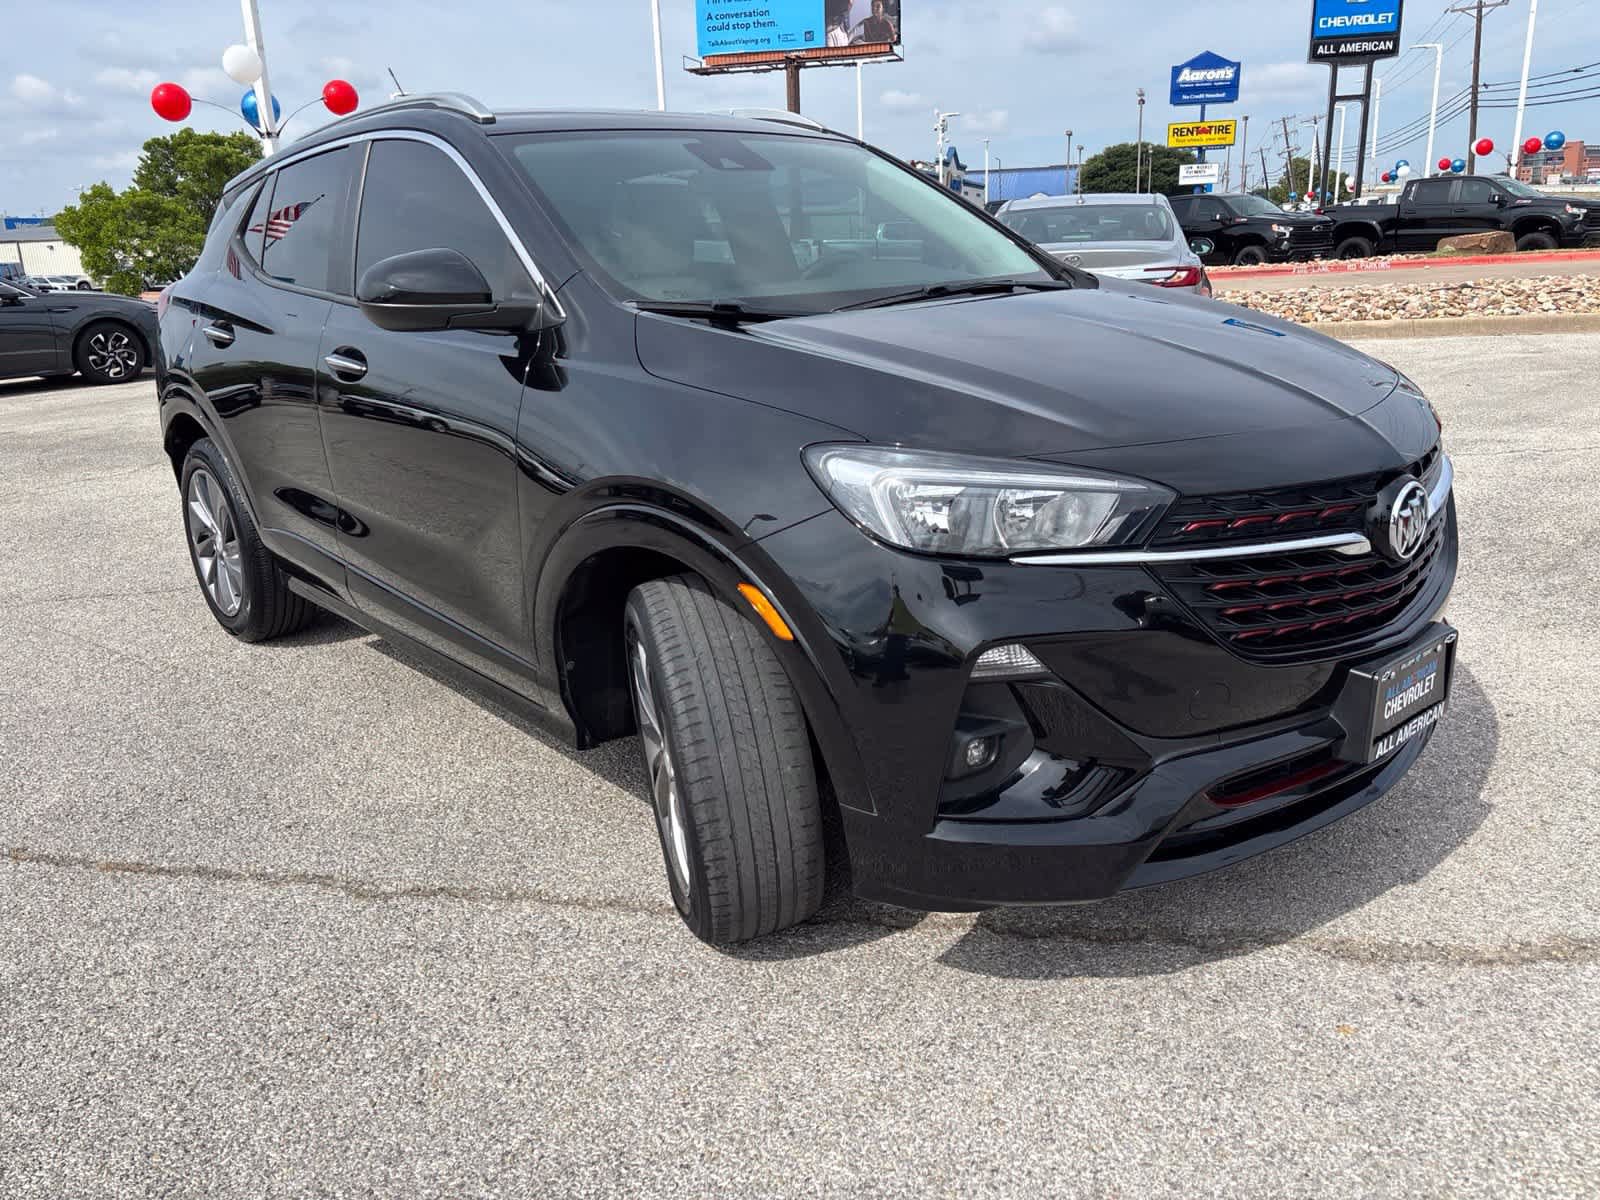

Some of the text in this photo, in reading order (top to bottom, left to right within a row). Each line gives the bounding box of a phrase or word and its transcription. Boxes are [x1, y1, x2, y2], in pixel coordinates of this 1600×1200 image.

[706, 8, 770, 21] A conversation
[1319, 12, 1394, 29] CHEVROLET
[706, 19, 778, 32] could stop them.
[708, 37, 771, 47] TalkAboutVaping.org
[1317, 40, 1394, 55] ALL AMERICAN
[1176, 66, 1236, 83] Aaron's
[1384, 672, 1437, 719] CHEVROLET
[1376, 701, 1446, 759] ALL AMERICAN
